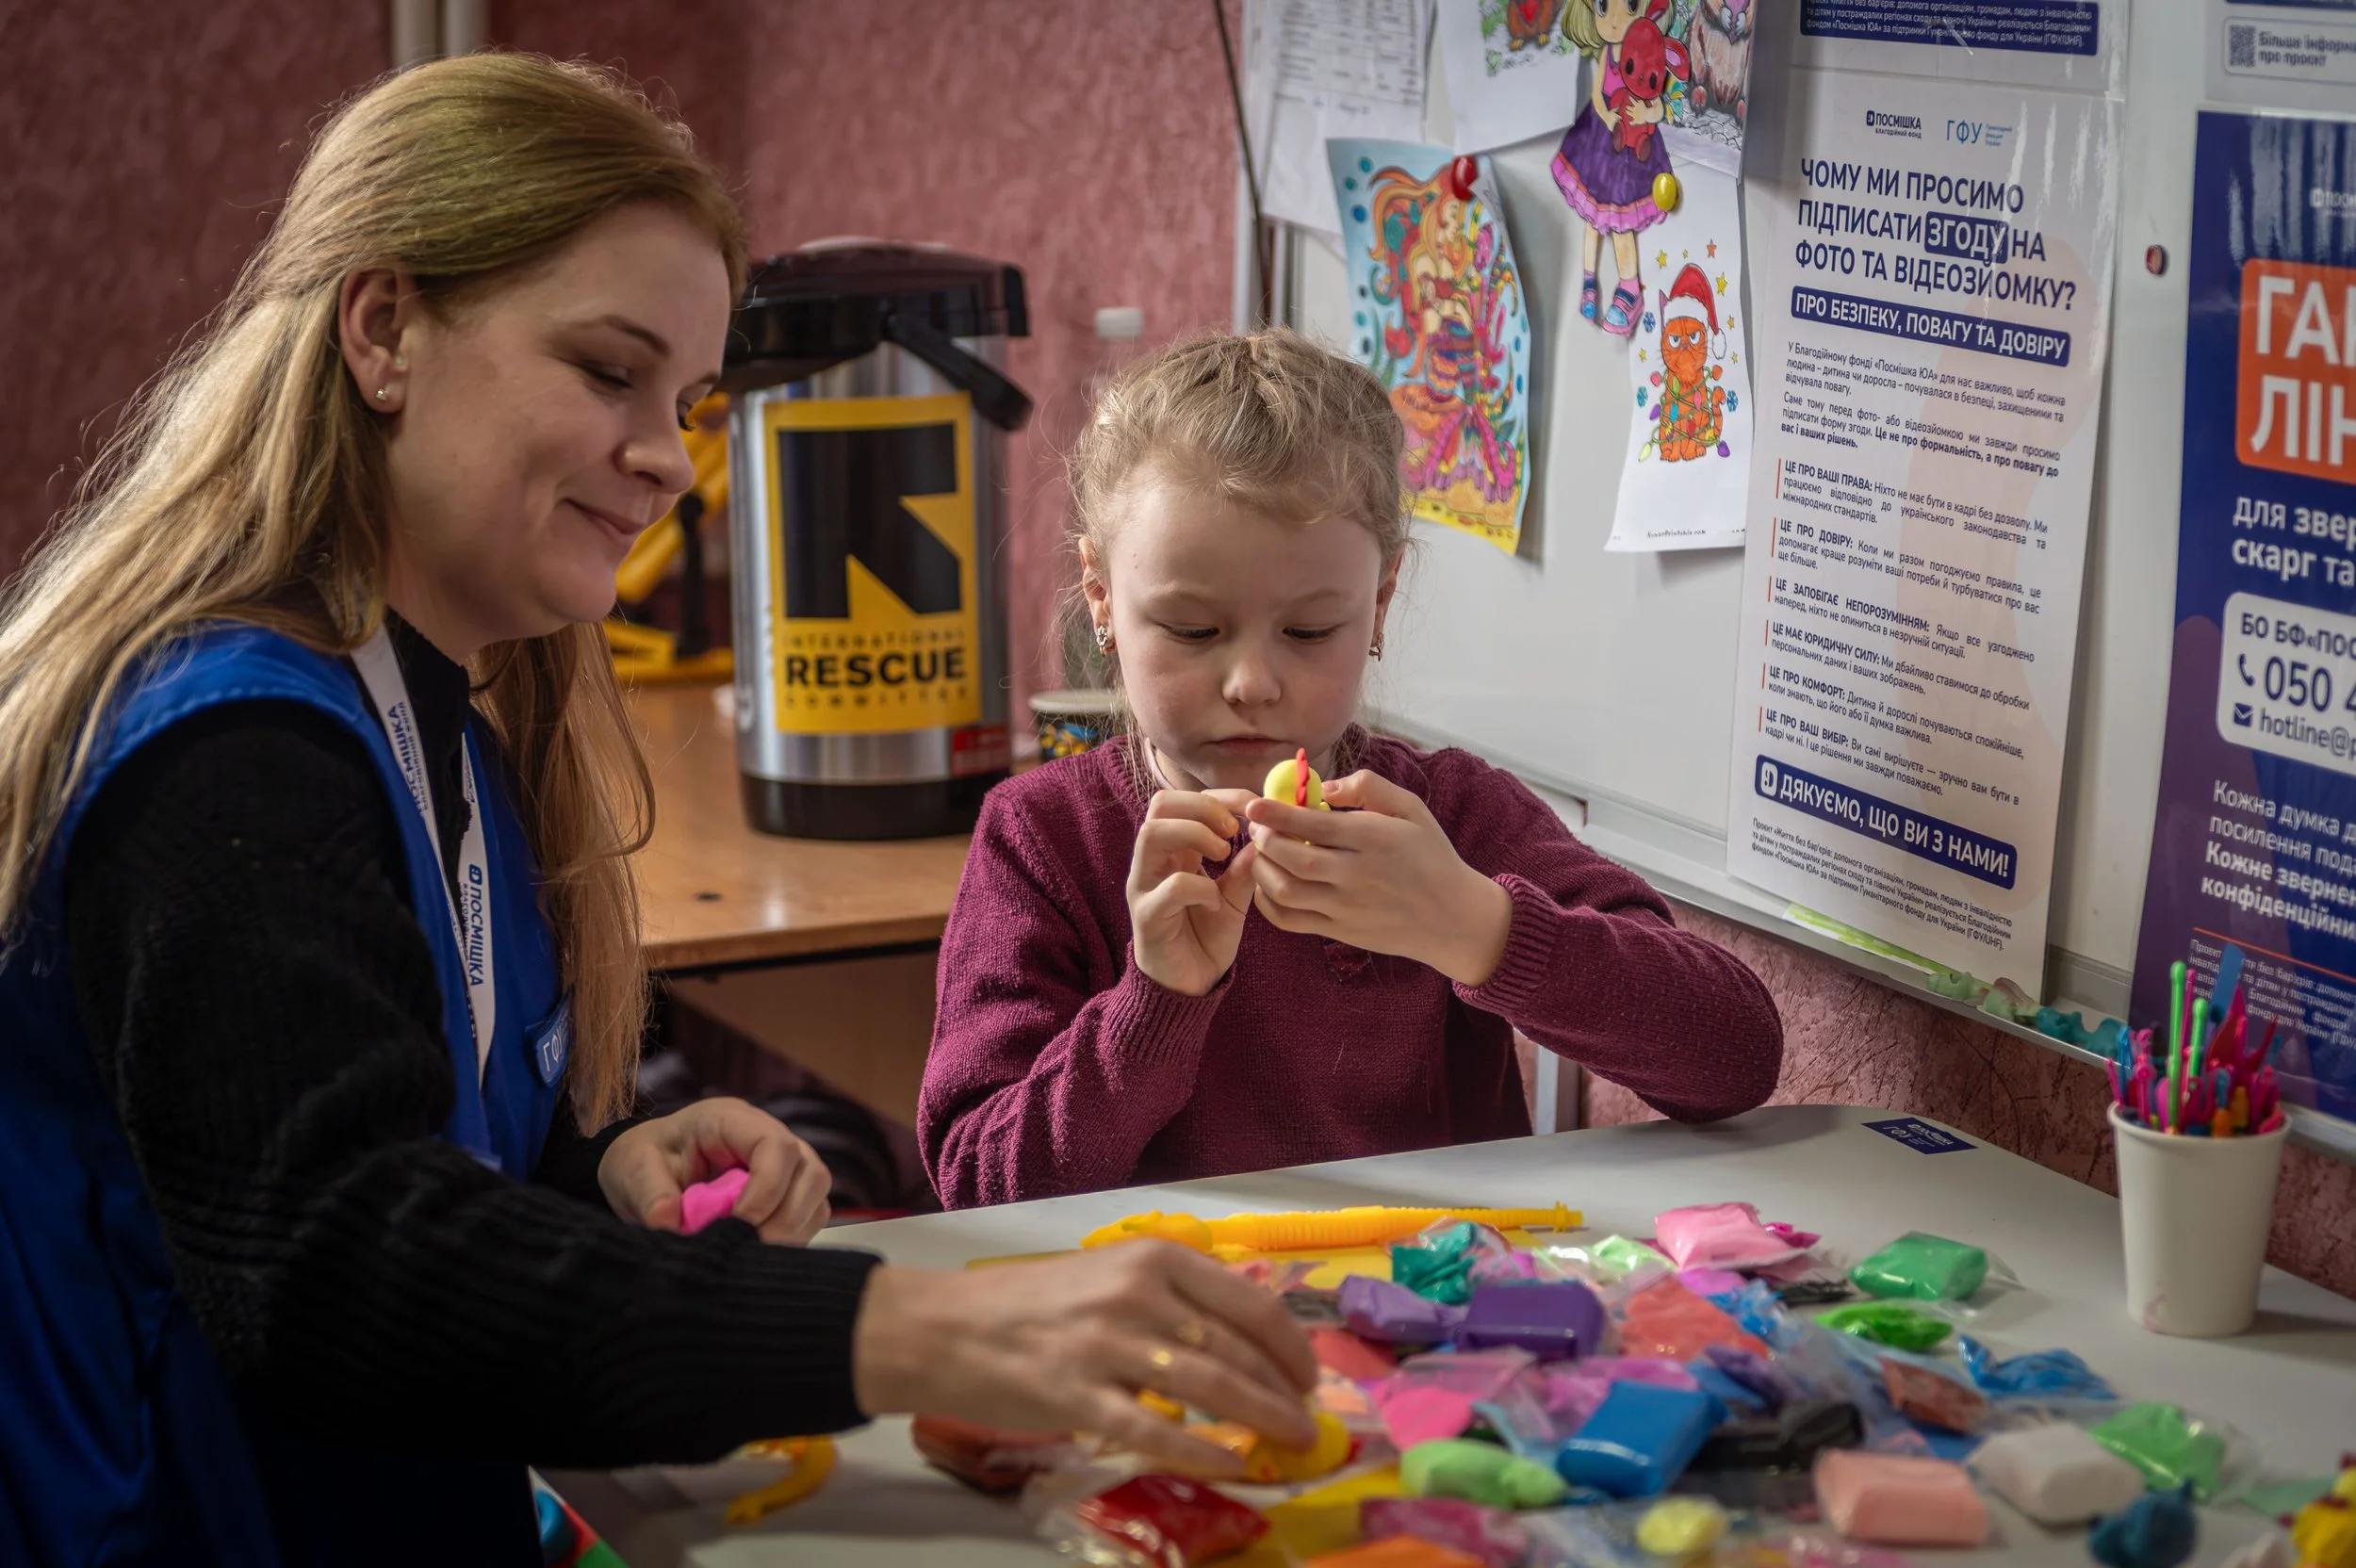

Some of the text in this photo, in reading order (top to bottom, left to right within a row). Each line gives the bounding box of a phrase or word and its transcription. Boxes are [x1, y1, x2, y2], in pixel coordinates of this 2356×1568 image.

[1875, 113, 1922, 129] ПОСМІШКА
[1947, 120, 1983, 144] ГФУ
[1799, 157, 2025, 213] ЧОМУ МИ ПРОСИМО
[1797, 199, 2048, 261] ПІДПИСАТИ ЗГОДУ НА
[1794, 239, 2076, 311] ФОТО ТА ВІДЕОЗЙОМКУ?
[1795, 292, 2066, 360] ПРО БЕЗПЕКУ, ПОВАГУ ТА ДОВІРУ
[1785, 373, 1851, 397] відчувала повагу.
[1788, 341, 2065, 406] У Благодійному фонді «Посмішка ЮА» для нас важливо, щоб кожна
[1781, 423, 1794, 433] вас
[1800, 427, 1825, 441] ваших
[1826, 432, 1857, 448] рішень.
[1782, 408, 1819, 424] підписати
[1821, 415, 1846, 433] форму
[1848, 423, 1873, 436] згоди.
[1874, 426, 1887, 440] Це
[1889, 433, 1899, 442] не
[1902, 434, 1918, 447] про
[1920, 436, 1983, 462] формальність,
[1993, 455, 2010, 467] про
[2013, 459, 2044, 476] повагу
[2046, 466, 2058, 478] до
[1782, 490, 1877, 523] міжнародних стандартів.
[1784, 477, 2046, 549] працюємо відповідно до українського законодавства та
[1785, 460, 1796, 474] ЦЕ
[1798, 463, 1815, 477] ПРО
[1817, 467, 1840, 483] ВАШІ
[1841, 473, 1872, 491] ПРАВА:
[1874, 482, 1895, 497] Ніхто
[1897, 490, 1907, 499] не
[1909, 493, 1924, 504] має
[1926, 494, 1945, 509] бути
[1954, 503, 1976, 517] кадрі
[1978, 506, 1992, 520] без
[1994, 513, 2032, 531] дозволу.
[2034, 519, 2048, 533] Ми
[2233, 496, 2286, 530] для
[1778, 550, 1817, 569] ще більше.
[1780, 519, 2041, 598] ЦЕ ПРО ДОВІРУ: Коли ми разом погоджуємо правила, це
[2232, 538, 2356, 588] скарг та
[1775, 578, 2035, 662] ЦЕ ЗАПОБІГАЄ НЕПОРОЗУМІННЯМ: Якщо все узгоджено
[1775, 595, 1807, 613] наперед,
[1808, 605, 1827, 617] ніхто
[1829, 611, 1839, 621] не
[1841, 614, 1881, 633] опиниться
[1889, 629, 1930, 647] незручній
[1931, 641, 1965, 659] ситуації.
[2241, 612, 2269, 639] БО
[786, 646, 967, 687] RESCUE
[1772, 639, 1823, 662] персональних
[1824, 656, 1847, 670] даних
[1853, 664, 1877, 679] ваших
[1879, 673, 1925, 694] зображень.
[1773, 622, 2029, 710] ЦЕ МАЄ ЮРИДИЧНУ СИЛУ: Ми дбайливо ставимося до обробки
[2265, 656, 2332, 712] 050
[1779, 774, 2009, 878] ДЯКУЄМО, ЩО ВИ З НАМИ!
[2212, 779, 2340, 836] Кожна думка
[2205, 840, 2273, 881] Кожне
[2209, 816, 2312, 861] посилення
[469, 886, 484, 987] ПОСМІШКА
